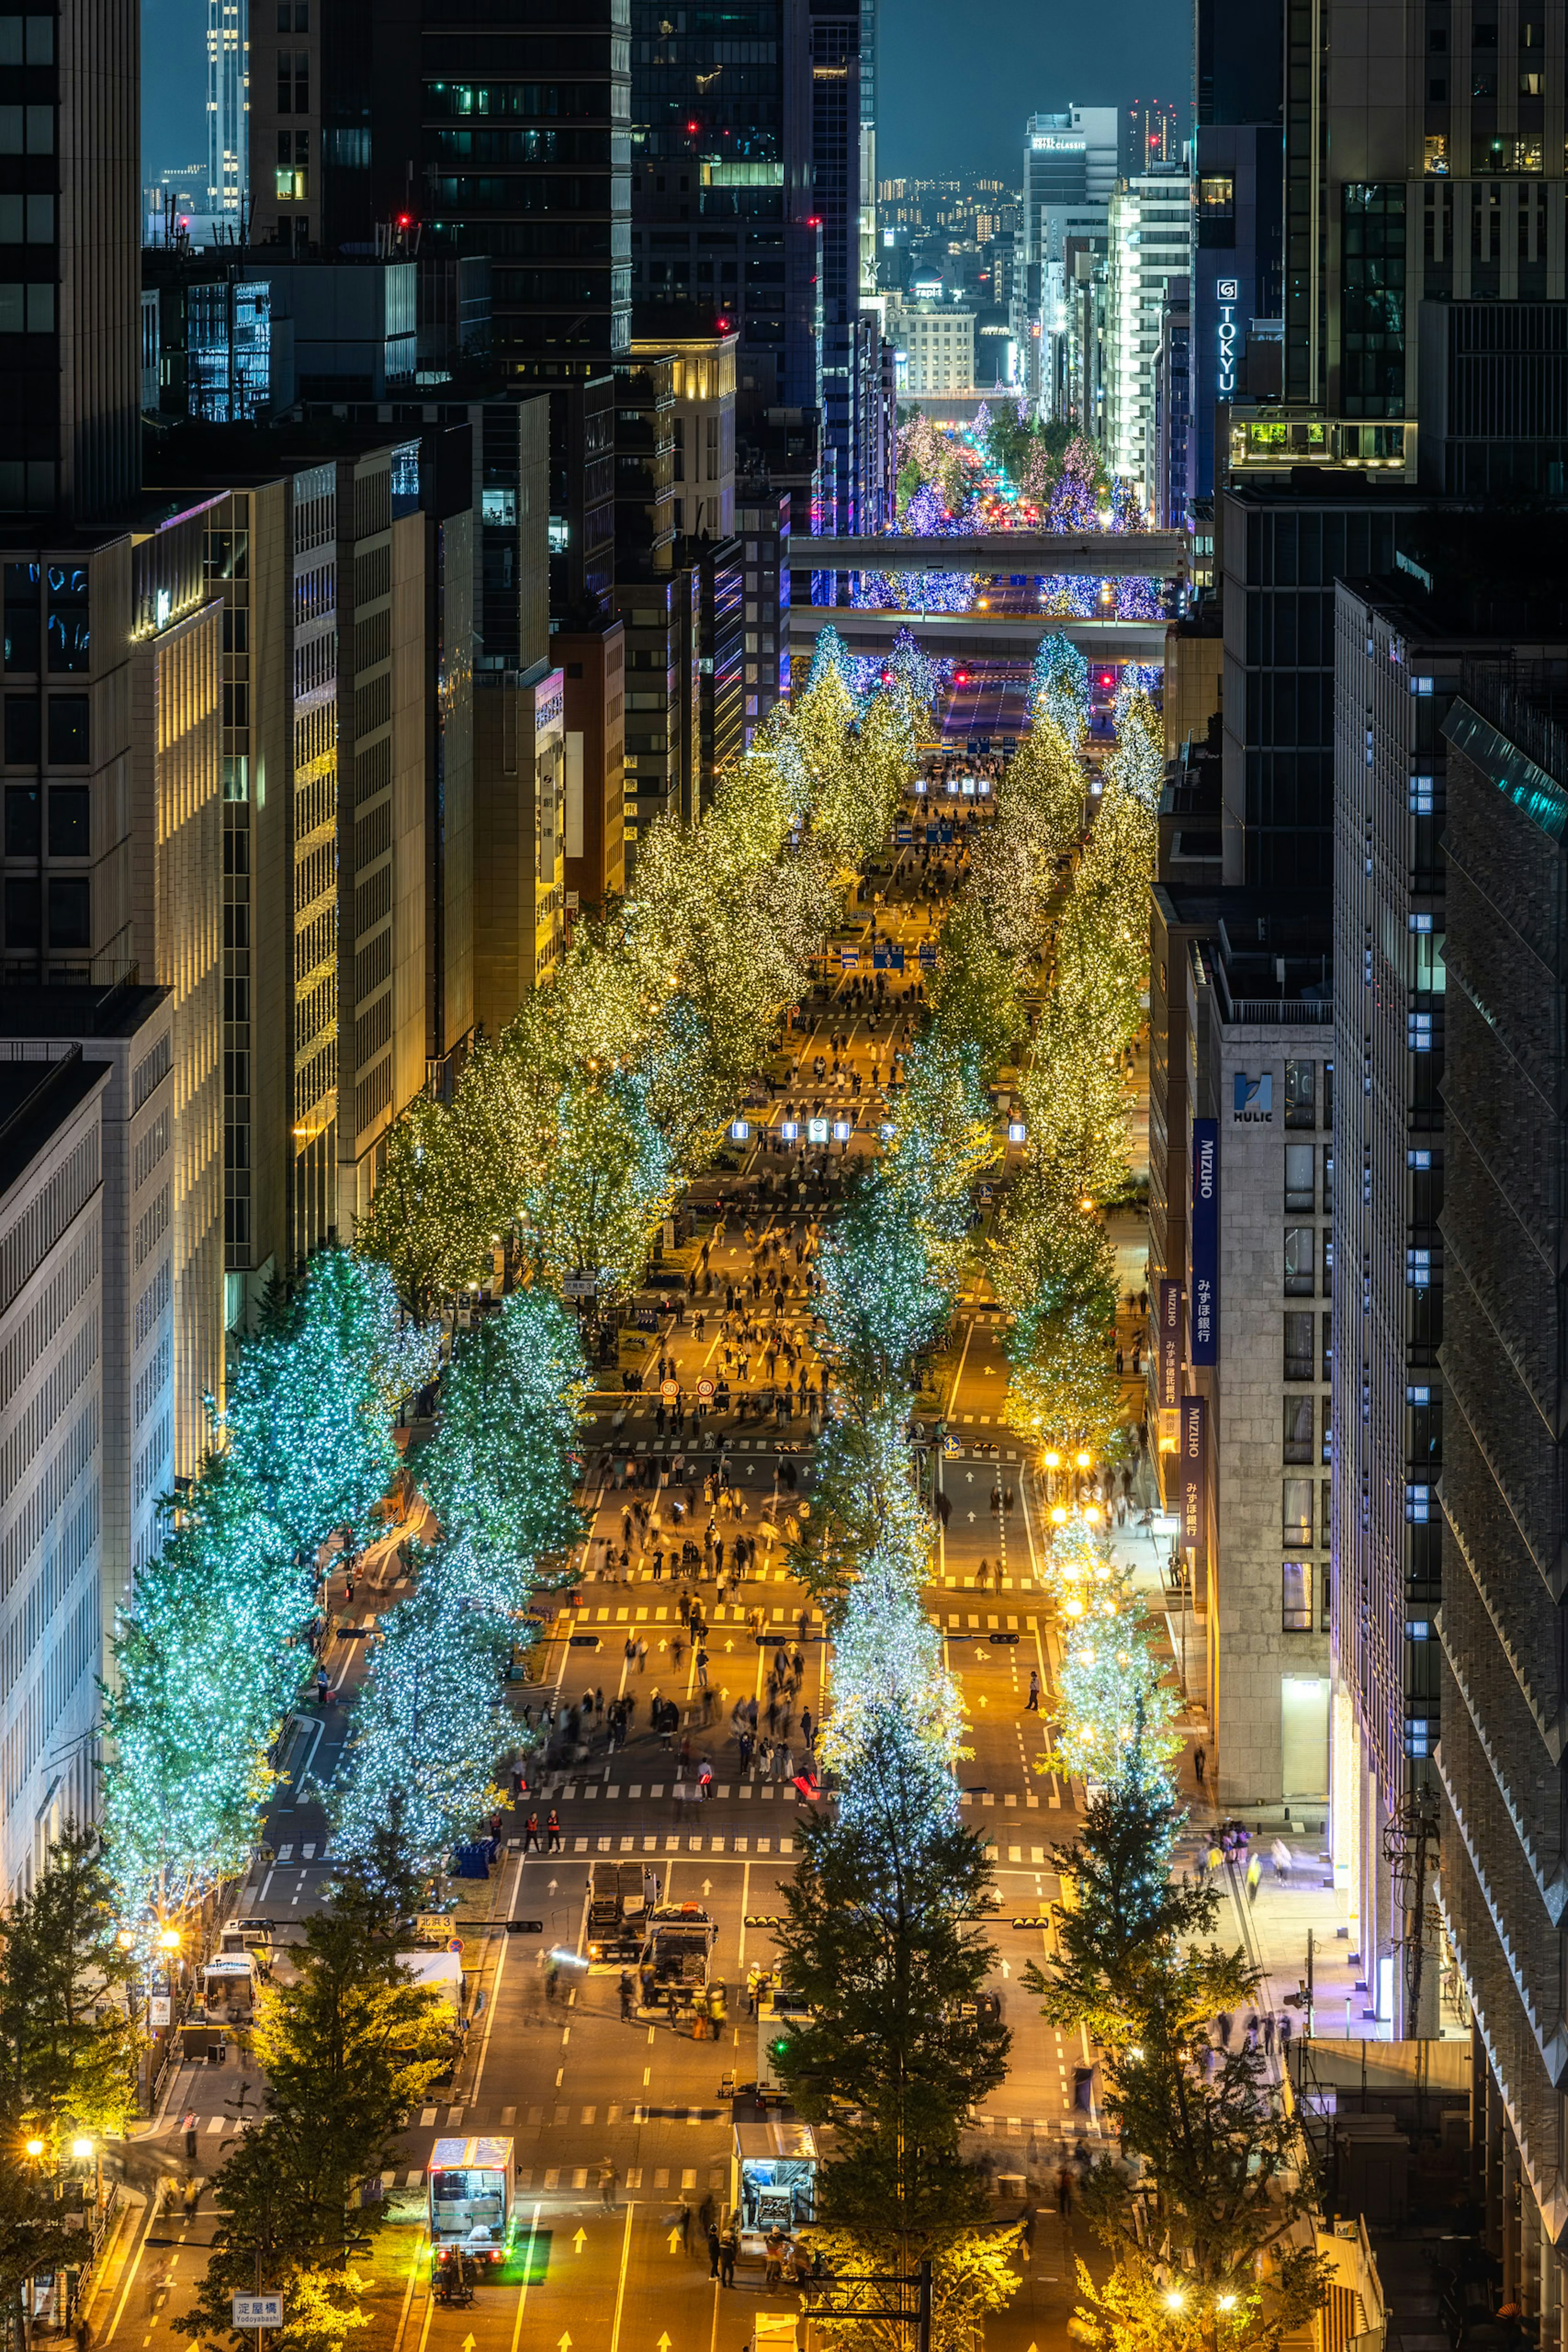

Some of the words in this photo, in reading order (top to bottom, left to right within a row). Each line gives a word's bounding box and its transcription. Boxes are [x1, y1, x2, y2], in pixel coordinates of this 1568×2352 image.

[1218, 306, 1236, 391] TOKYU
[1234, 1112, 1272, 1122] HULIC
[1200, 1139, 1213, 1199] MIZUHO
[1168, 1287, 1177, 1327] MIZUHO
[1198, 1279, 1211, 1342] みずほ銀行
[1166, 1341, 1176, 1404] みずほ信託銀行
[1189, 1407, 1200, 1458] MIZUHO
[1186, 1483, 1197, 1537] みずほ銀行
[238, 2302, 277, 2315] 淀屋橋
